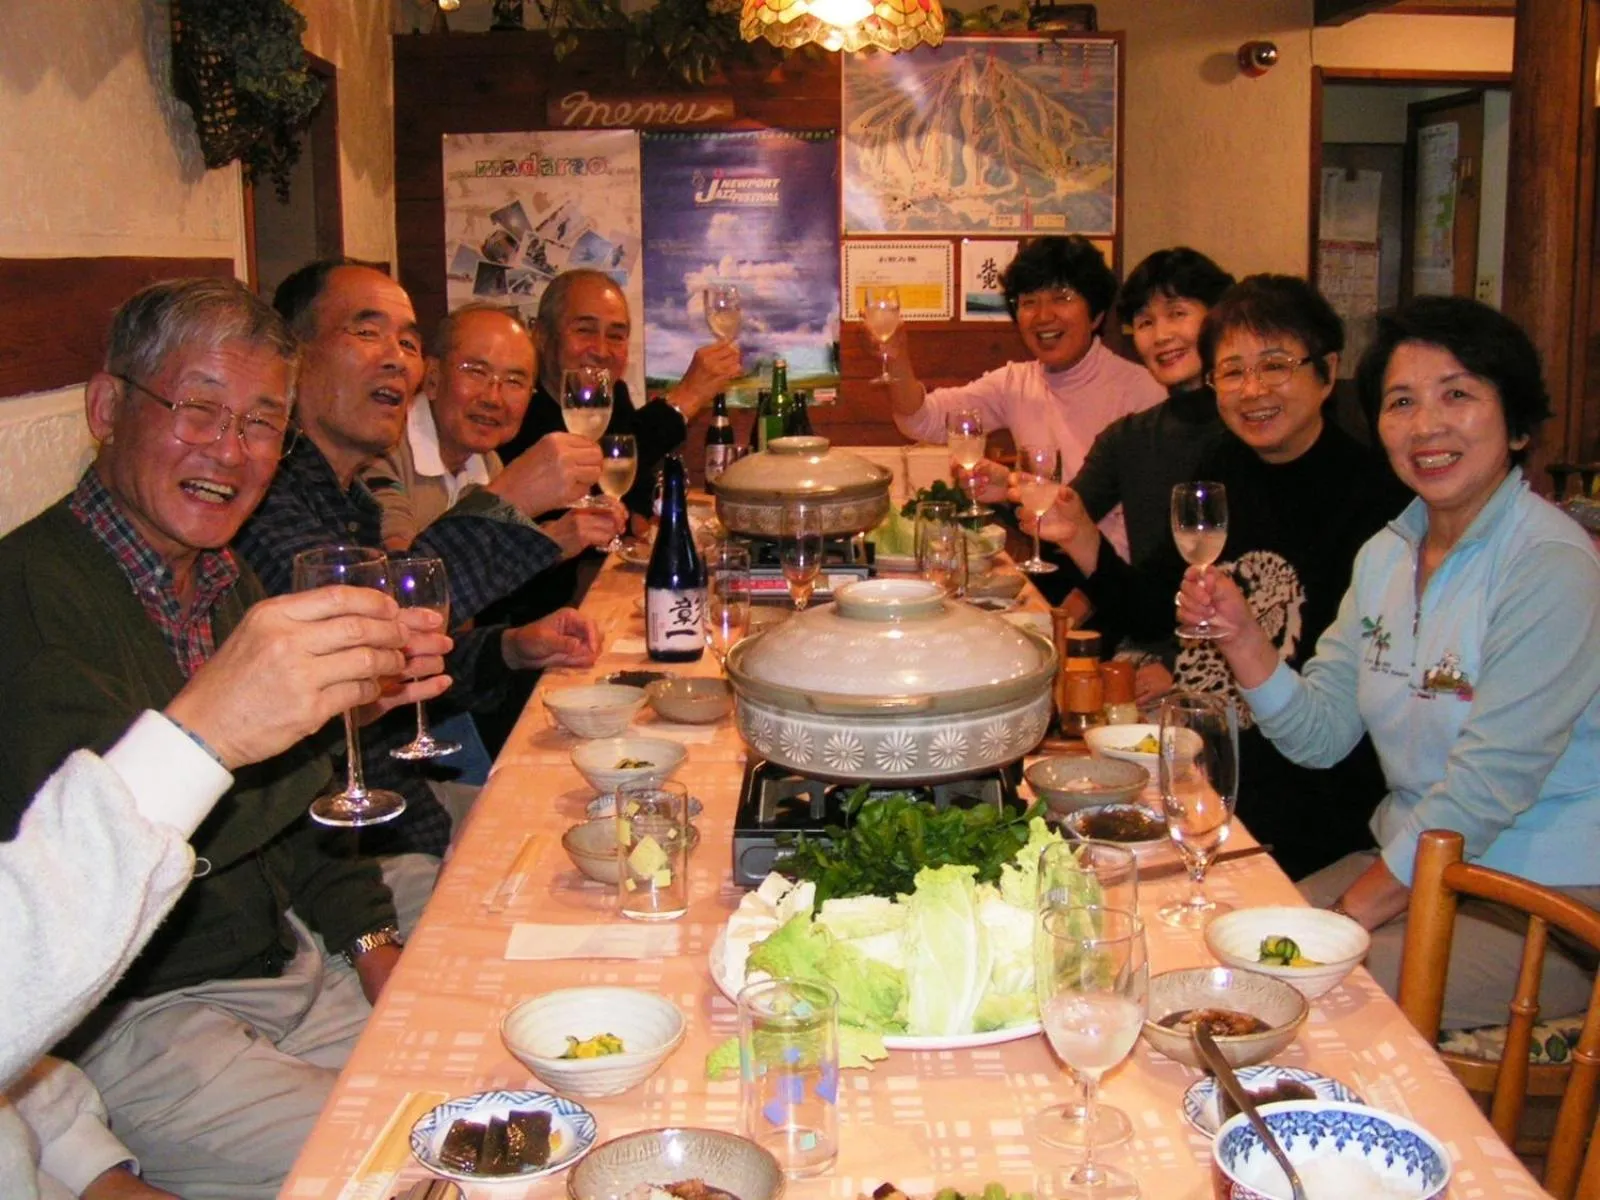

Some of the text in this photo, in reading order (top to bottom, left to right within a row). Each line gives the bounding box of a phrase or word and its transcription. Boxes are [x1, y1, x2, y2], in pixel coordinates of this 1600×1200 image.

[561, 91, 725, 126] menu
[475, 152, 608, 177] madarao
[721, 178, 781, 189] NEWPORT
